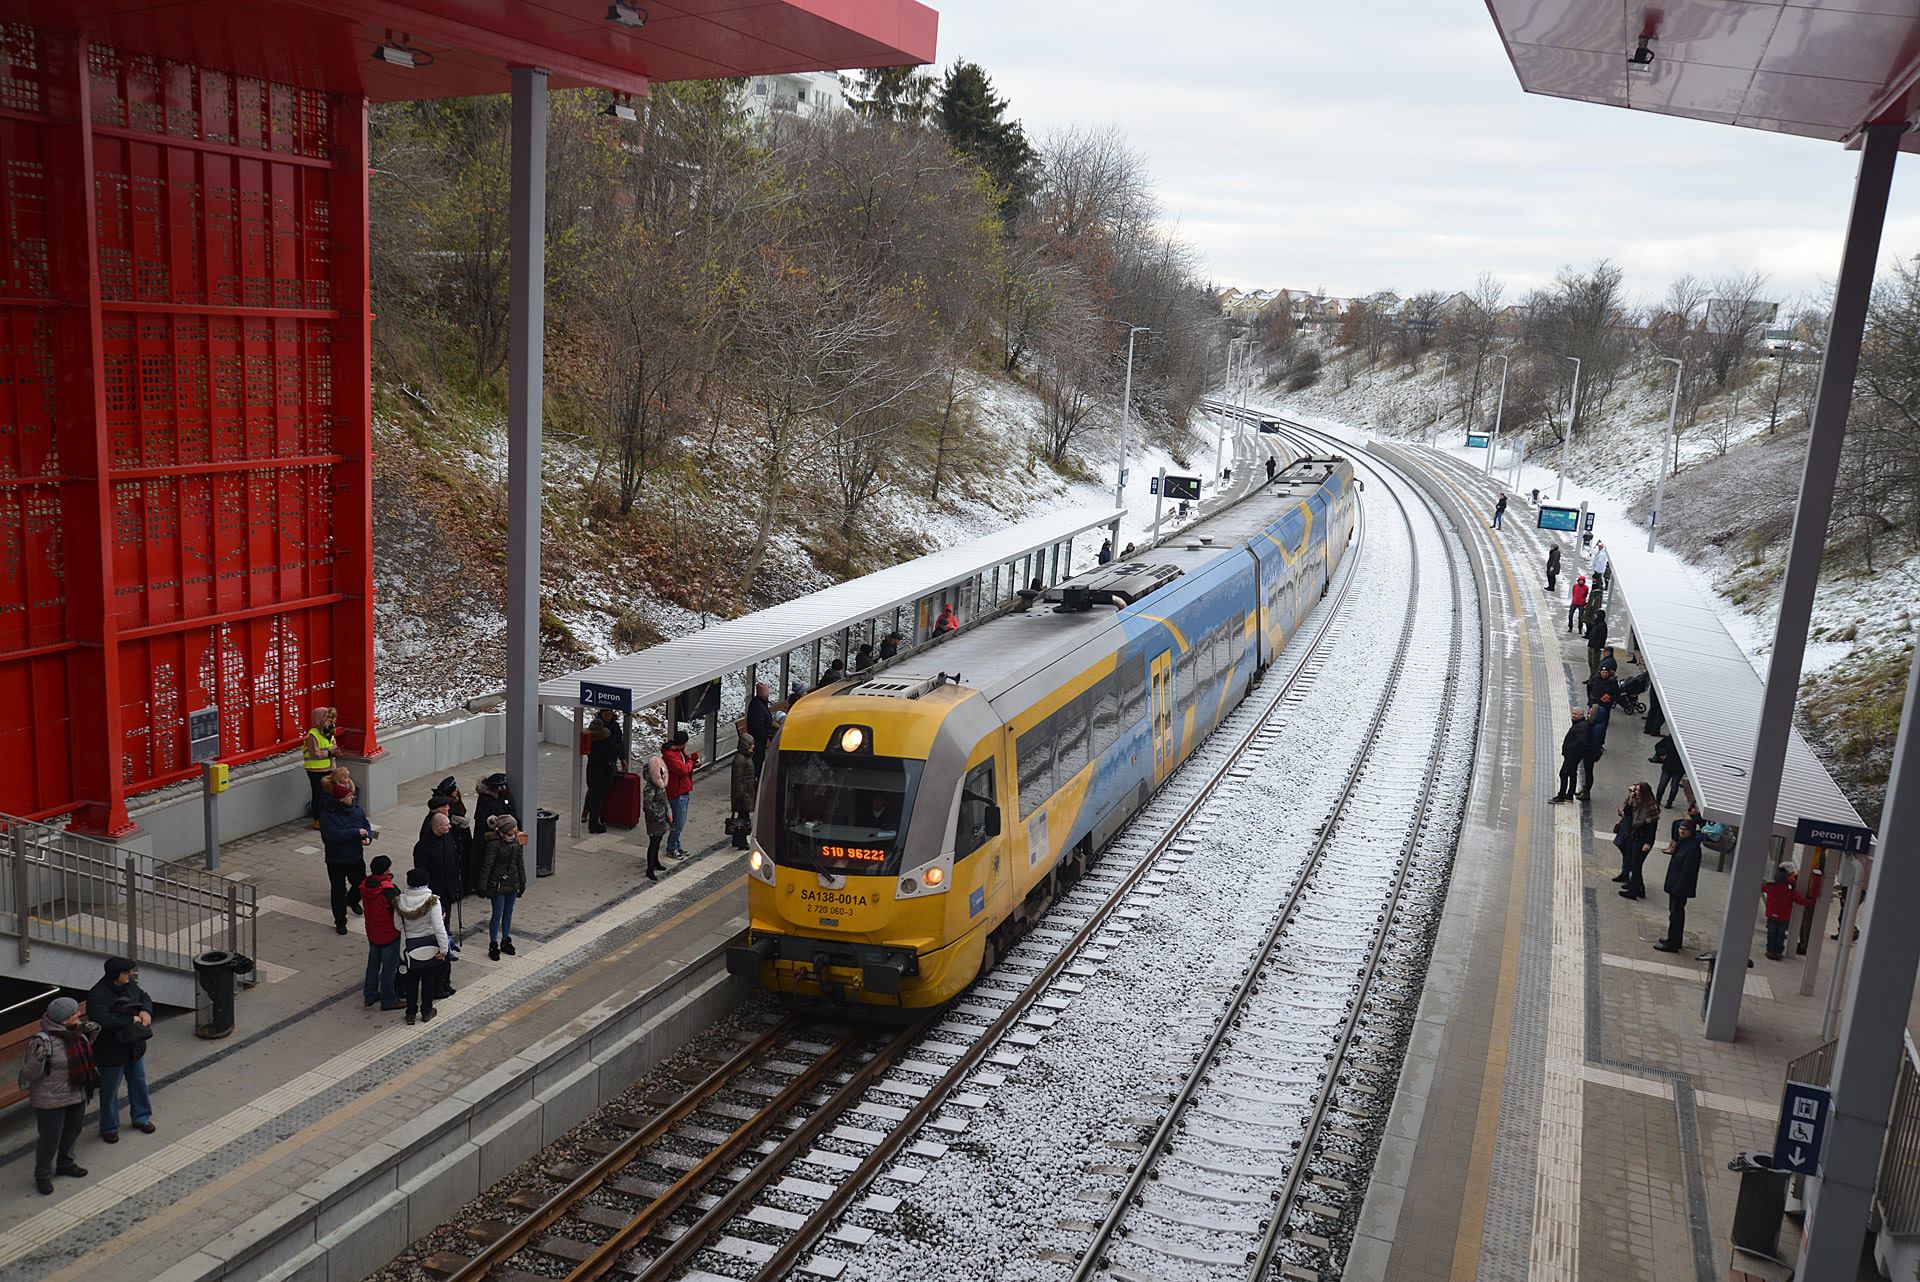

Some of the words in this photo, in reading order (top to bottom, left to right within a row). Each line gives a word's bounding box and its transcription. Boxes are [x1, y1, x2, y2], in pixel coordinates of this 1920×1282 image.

[584, 689, 593, 703] 2
[598, 692, 621, 701] peron
[1811, 829, 1845, 841] peron
[1854, 835, 1863, 850] 1
[822, 846, 844, 857] S10
[801, 889, 867, 906] SA138-001A
[807, 904, 812, 913] 2
[814, 905, 828, 914] 720
